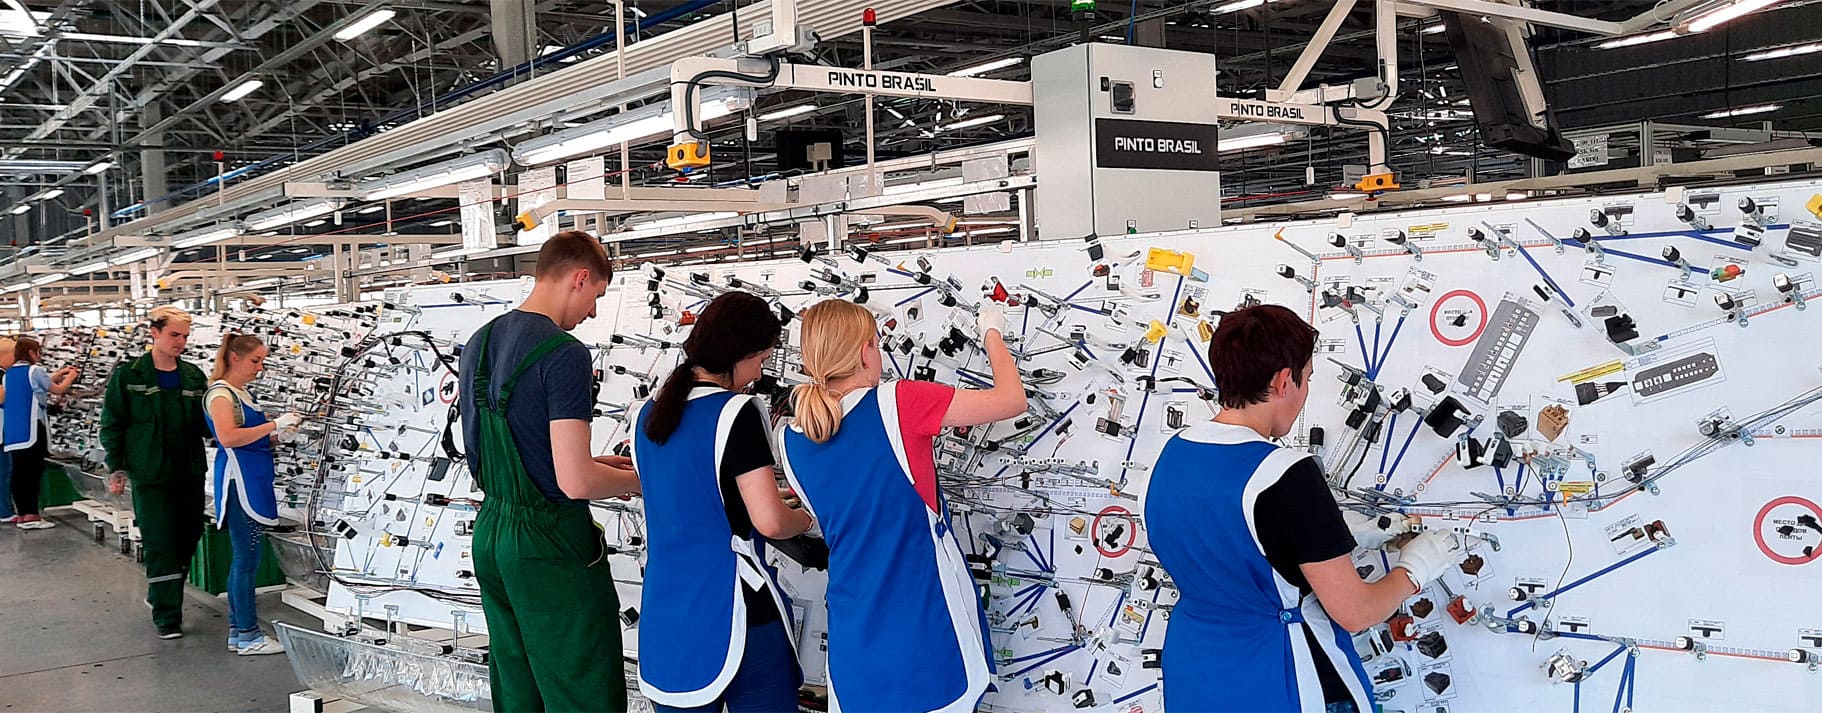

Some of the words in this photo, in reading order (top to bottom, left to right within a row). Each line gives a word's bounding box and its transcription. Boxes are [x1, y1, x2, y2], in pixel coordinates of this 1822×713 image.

[828, 71, 877, 87] PINTO
[882, 75, 936, 92] BRASIL
[1230, 103, 1264, 117] PINTO
[1267, 106, 1305, 120] BRASIL
[1114, 136, 1155, 152] PINTO
[1157, 138, 1202, 154] BRASIL
